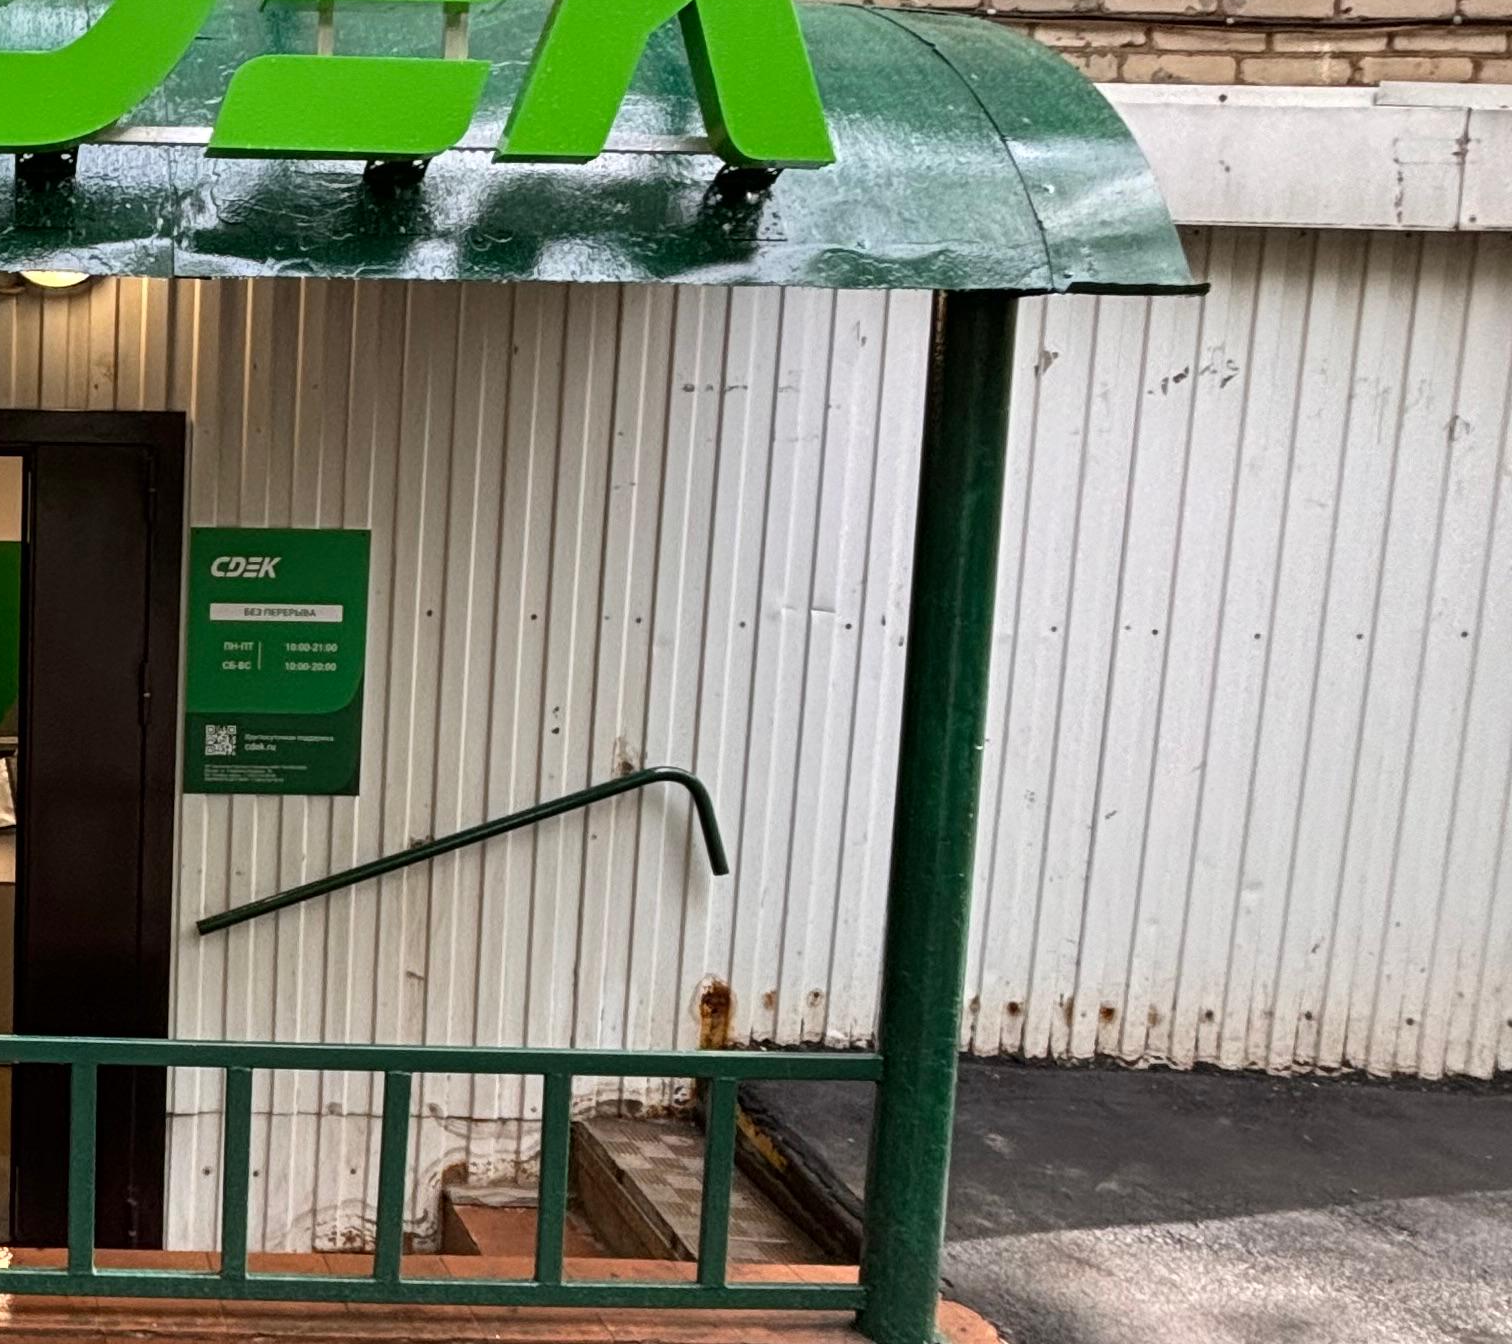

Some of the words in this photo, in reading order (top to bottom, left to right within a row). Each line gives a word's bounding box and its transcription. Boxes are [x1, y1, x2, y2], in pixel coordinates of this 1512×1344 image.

[210, 556, 282, 578] CDEK
[243, 607, 262, 617] БЕЗ
[263, 608, 317, 617] ПЕРЕРЫВА
[223, 641, 255, 651] ПН-ПТ
[221, 661, 252, 670] СБ-ВС
